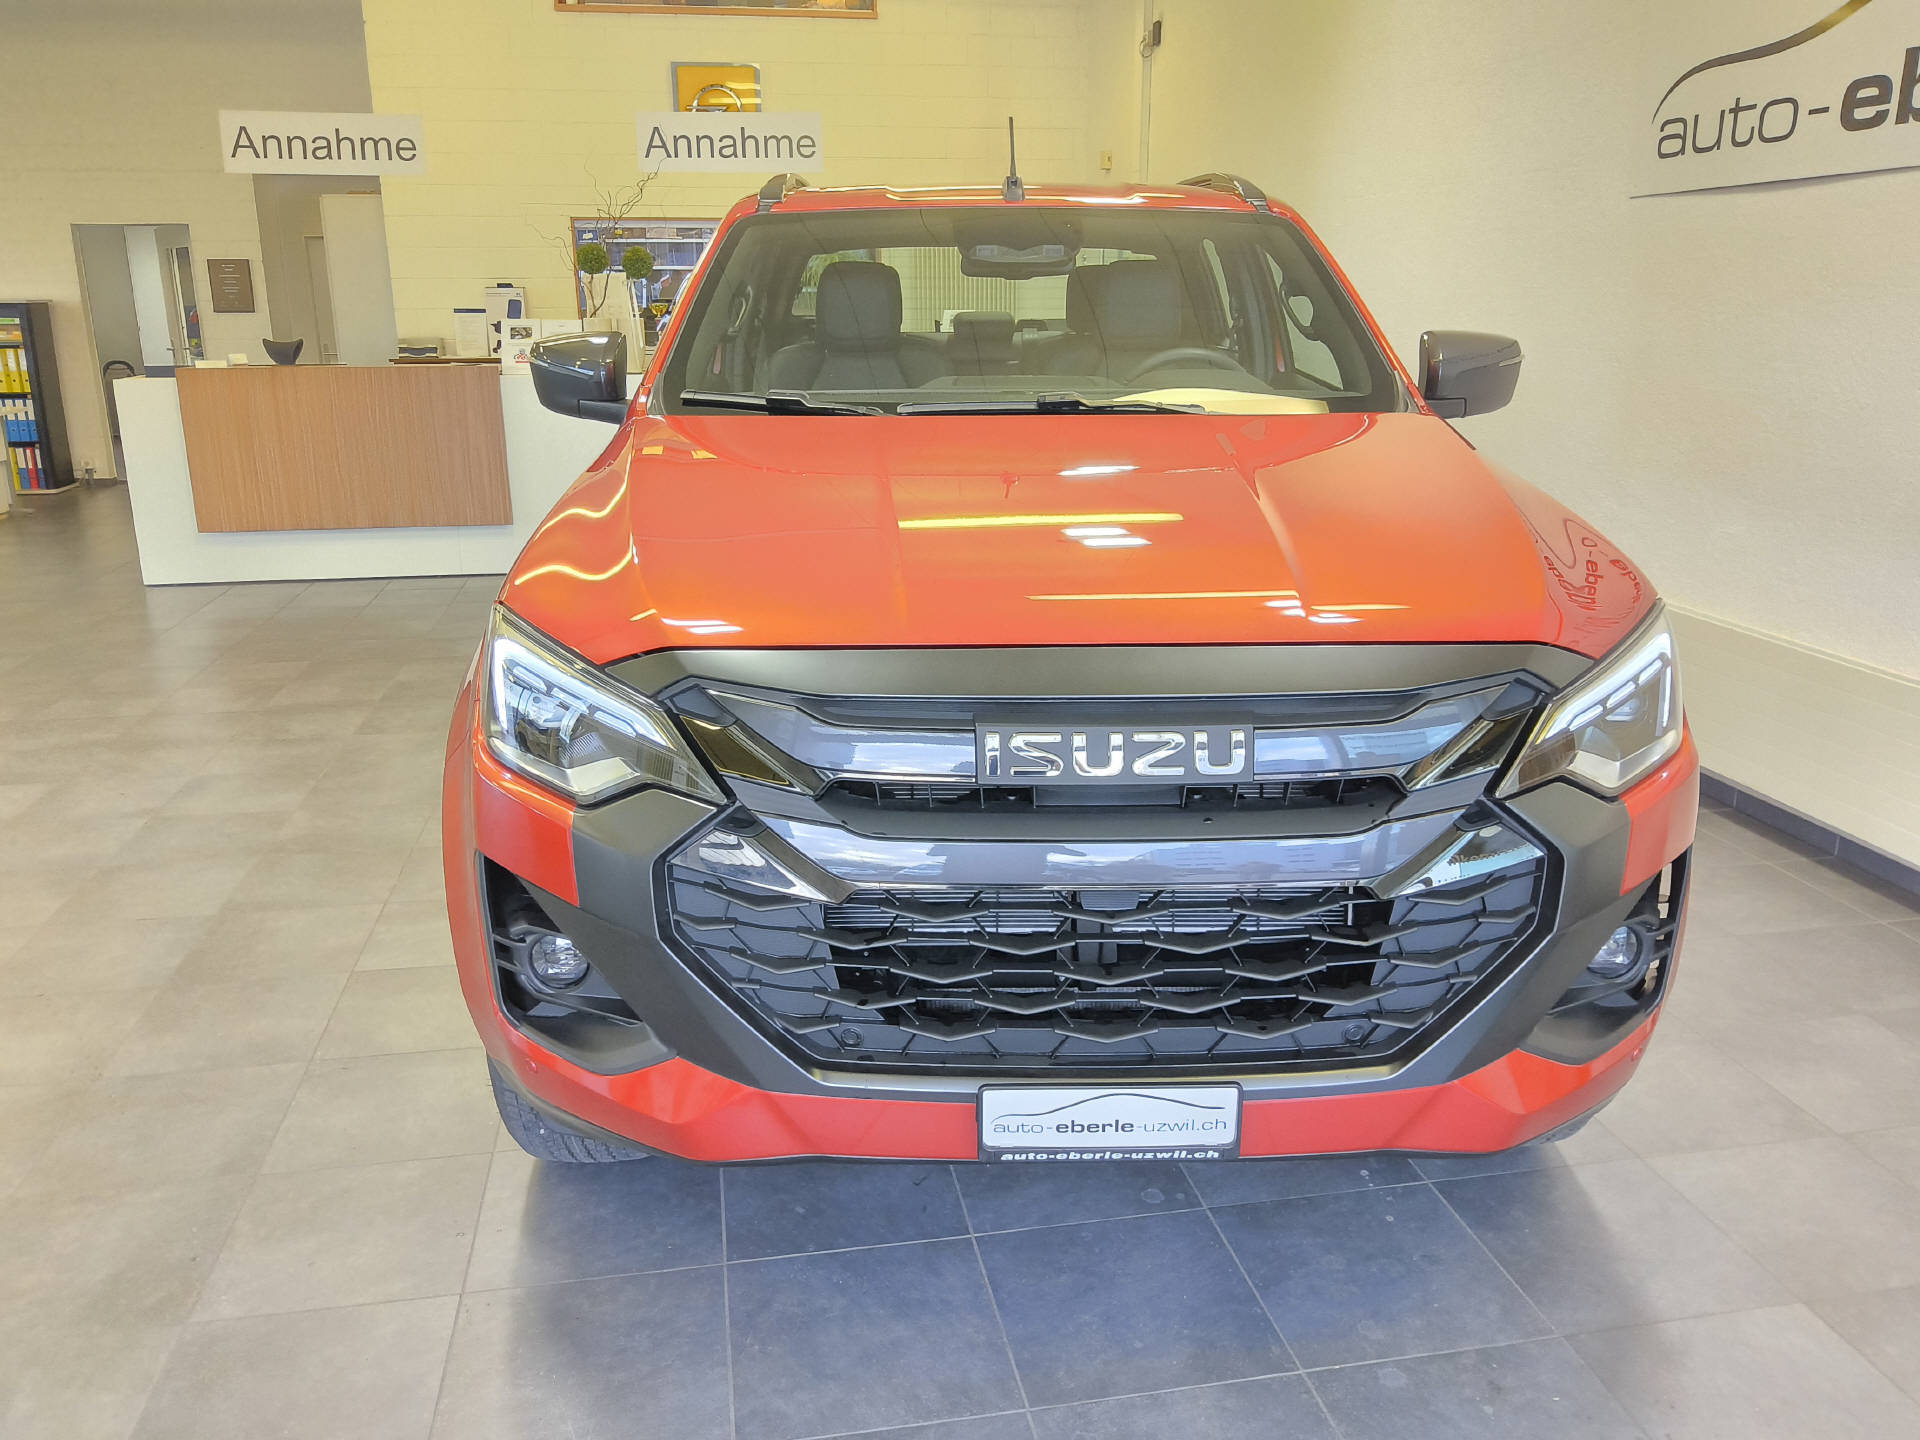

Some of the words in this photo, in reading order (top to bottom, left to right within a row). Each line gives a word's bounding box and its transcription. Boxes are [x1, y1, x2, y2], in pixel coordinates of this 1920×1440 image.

[231, 125, 417, 162] Annahme
[645, 126, 816, 159] Annahme
[984, 730, 1246, 777] ISUZU
[992, 1117, 1228, 1134] auto-eberle-uzwil.ch
[1000, 1150, 1220, 1161] auto-eberle-uzwil.ch
